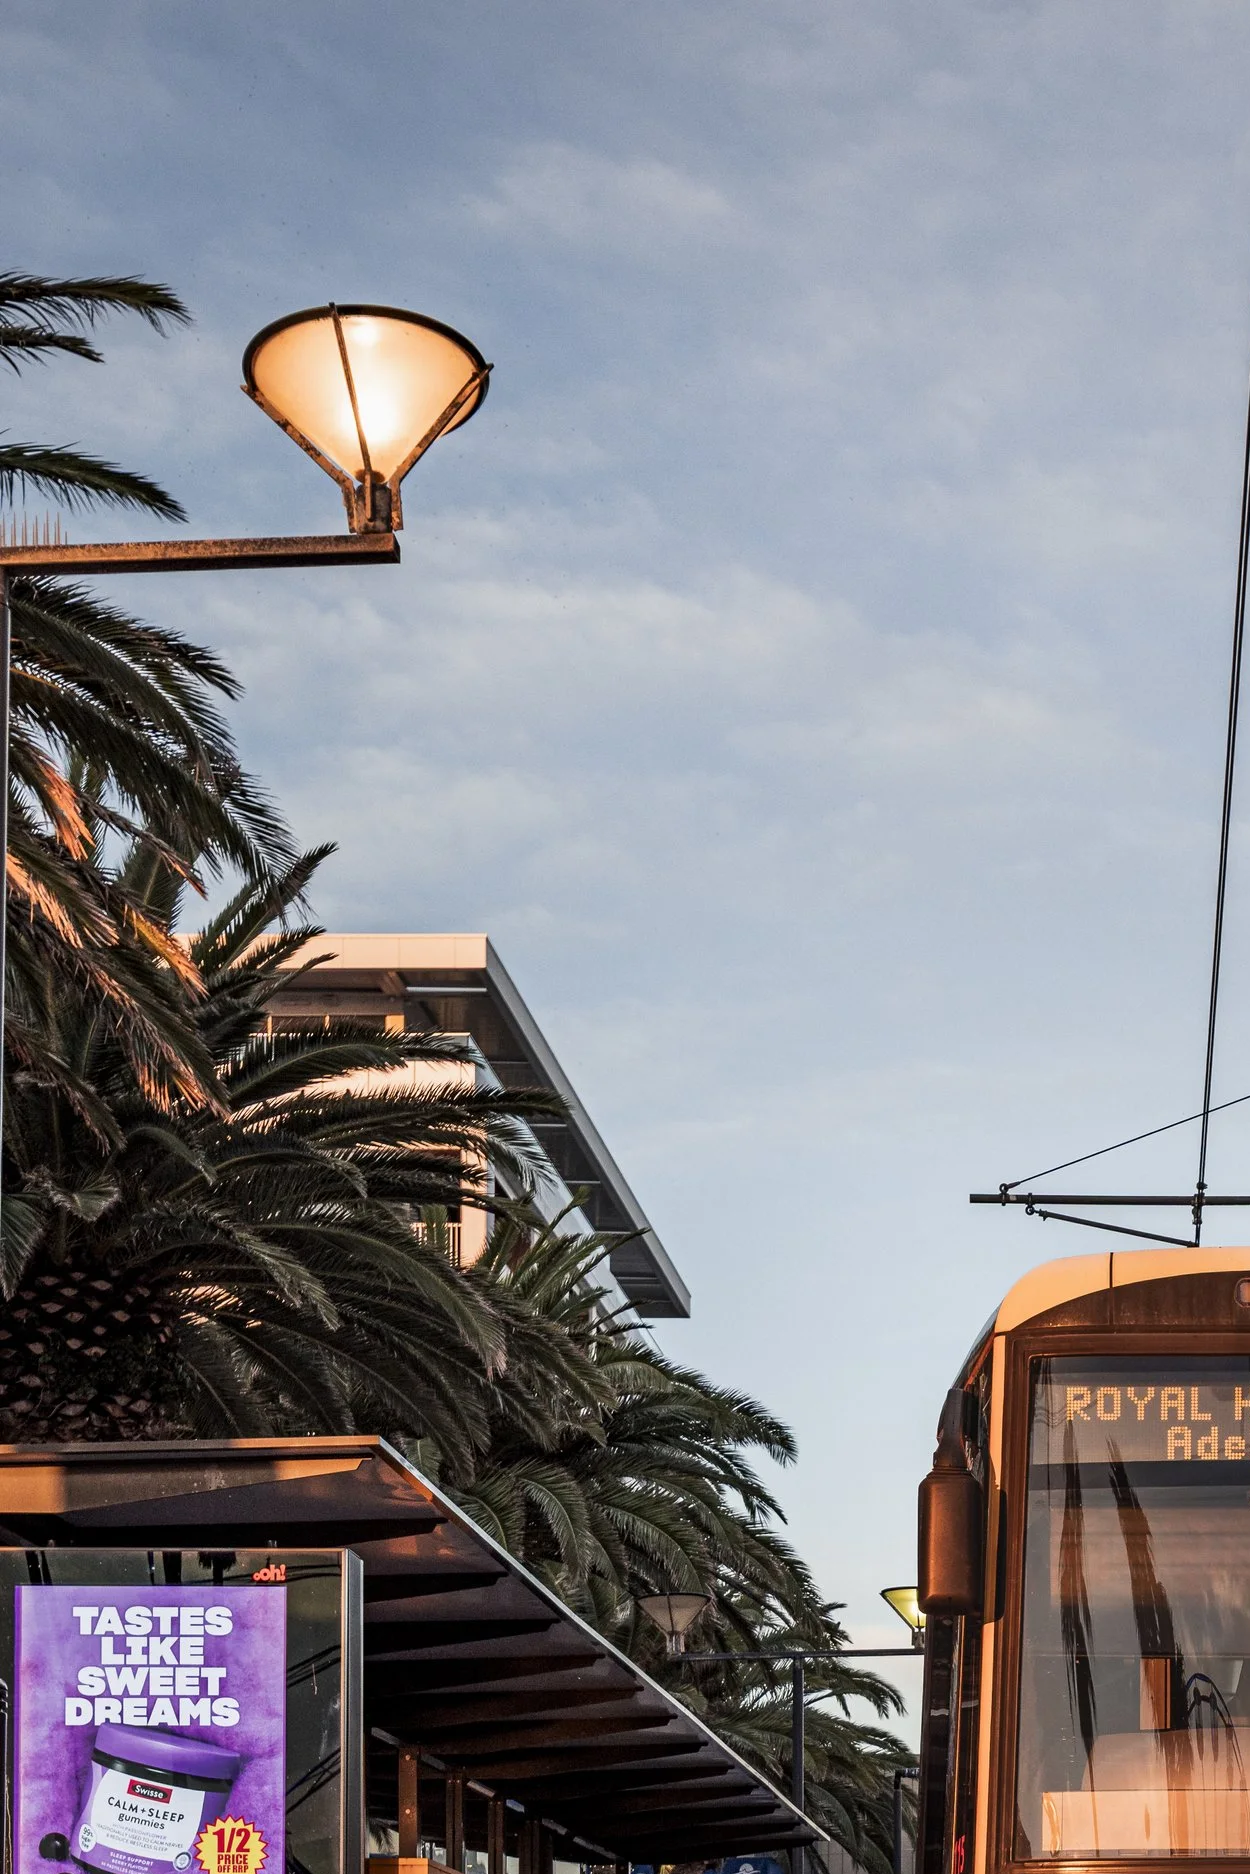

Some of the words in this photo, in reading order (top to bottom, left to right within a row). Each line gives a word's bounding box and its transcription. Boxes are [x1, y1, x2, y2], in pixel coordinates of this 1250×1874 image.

[1066, 1386, 1212, 1421] ROYAL
[73, 1606, 233, 1636] TASTES
[101, 1636, 205, 1665] LIKE
[77, 1666, 227, 1696] SWEET
[65, 1697, 241, 1727] DREAMS
[134, 1784, 164, 1799] Swisse
[107, 1796, 138, 1813] CALM
[147, 1808, 185, 1823] SLEEP
[118, 1812, 165, 1830] gummies
[212, 1828, 251, 1853] 1/2
[217, 1854, 249, 1865] PRICE
[217, 1865, 231, 1873] OFF
[232, 1865, 249, 1873] RRP
